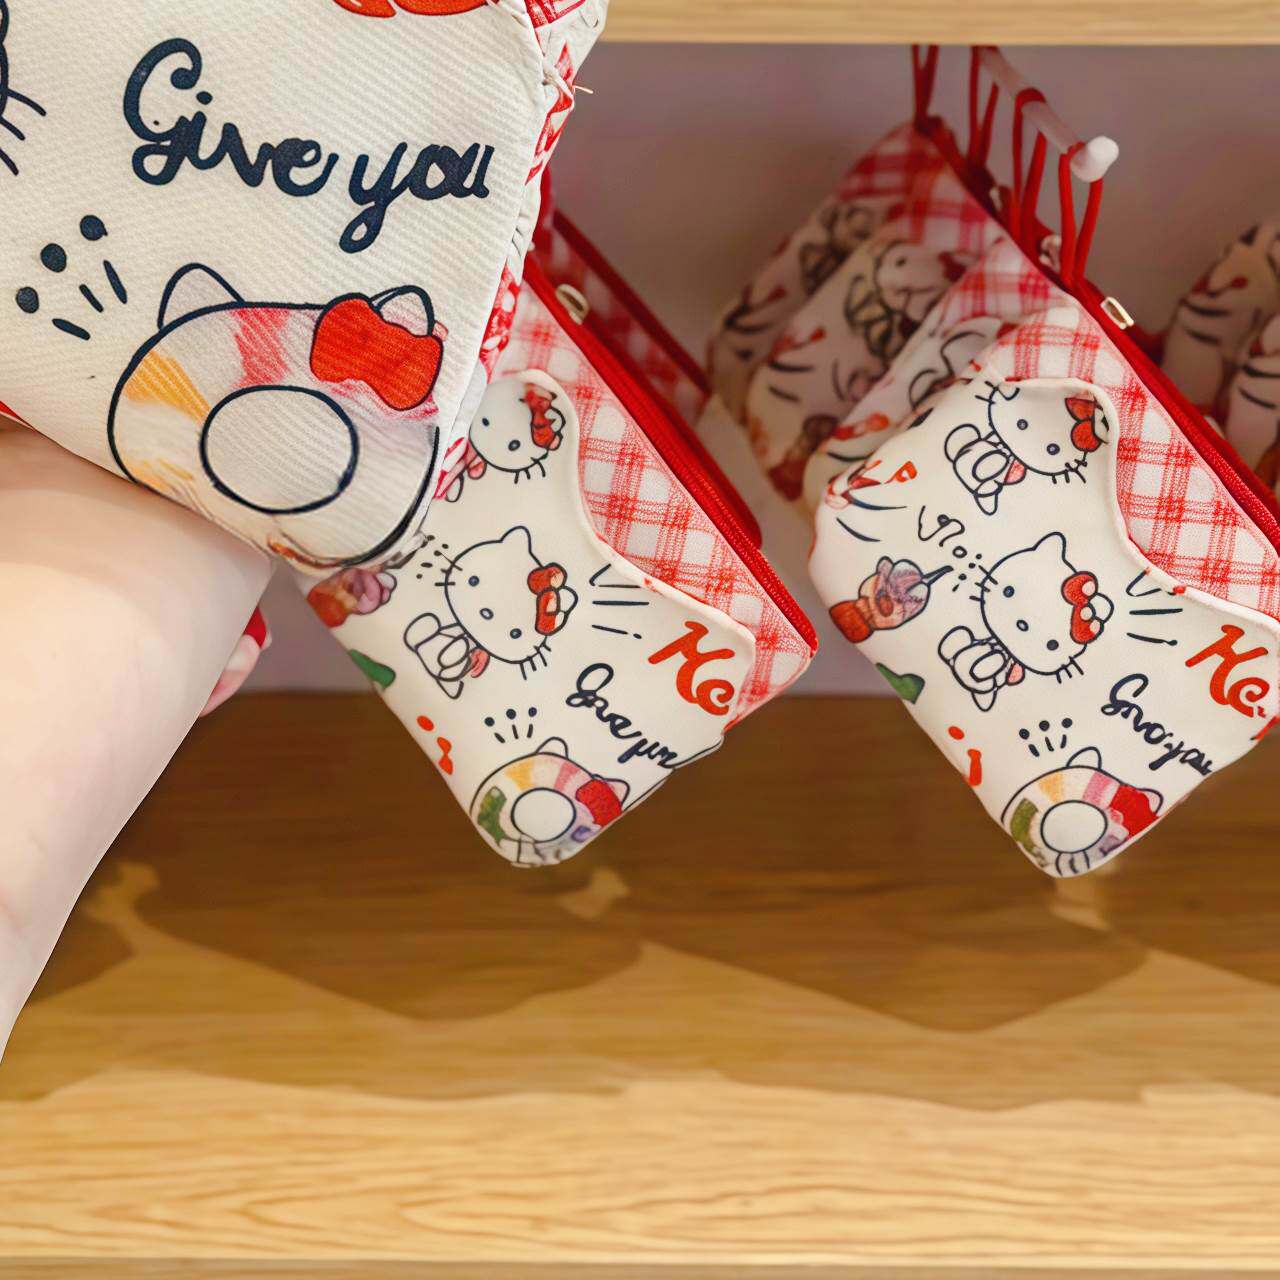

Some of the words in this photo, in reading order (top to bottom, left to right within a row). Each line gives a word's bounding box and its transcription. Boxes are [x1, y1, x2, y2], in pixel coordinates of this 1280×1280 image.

[122, 37, 340, 198] Give
[338, 141, 495, 255] you
[647, 620, 736, 716] He
